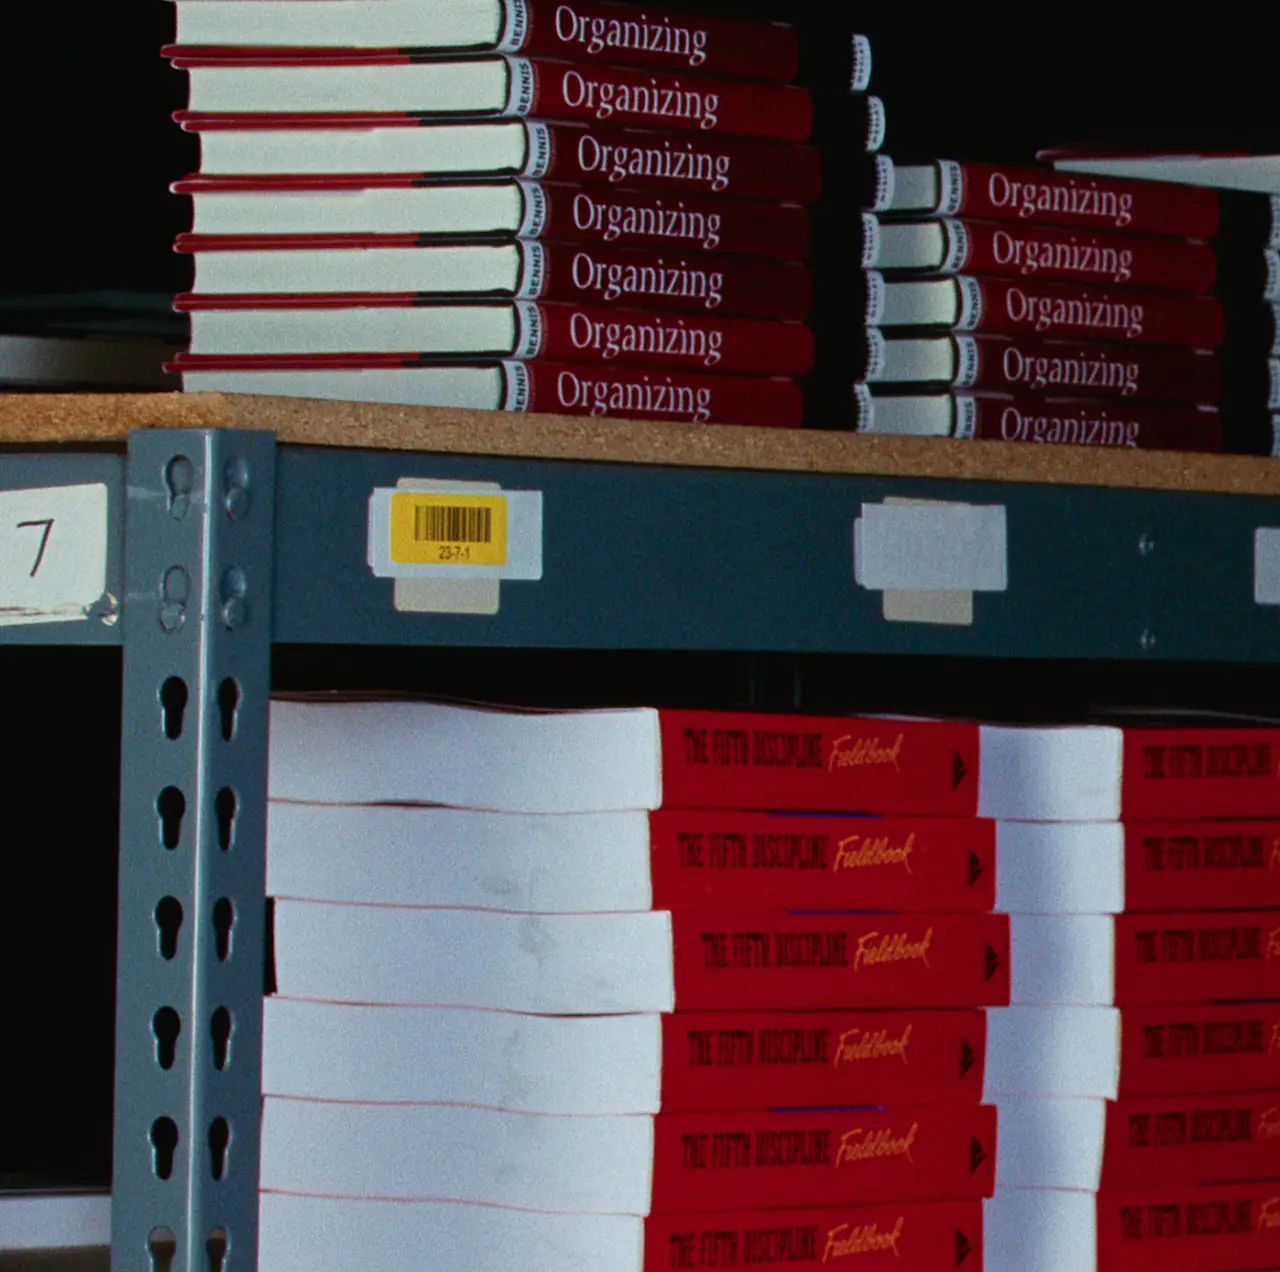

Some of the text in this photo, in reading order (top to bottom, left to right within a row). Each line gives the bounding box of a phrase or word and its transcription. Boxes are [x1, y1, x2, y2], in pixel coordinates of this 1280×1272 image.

[555, 5, 707, 66] Organizing
[517, 62, 529, 114] BENNIS
[562, 70, 719, 130] Organizing
[577, 135, 730, 192] Organizing
[573, 193, 721, 249] Organizing
[988, 172, 1134, 224] Organizing
[528, 245, 541, 295] BENNIS
[571, 252, 723, 309] Organizing
[993, 231, 1132, 282] Organizing
[526, 305, 539, 356] BENNIS
[569, 312, 722, 366] Organizing
[1006, 289, 1143, 338] Organizing
[557, 371, 711, 423] Organizing
[1003, 348, 1139, 395] Organizing
[1000, 408, 1139, 448] Organizing
[16, 518, 55, 578] 7
[684, 729, 904, 773] THE FIFTH DISCIPLINE Fieldbook
[678, 832, 916, 874] THE FIFTH DISCIPLINE Fieldbook
[701, 927, 933, 972] THE FIFTH DISCIPLINE Fieldbook
[688, 1023, 912, 1069] THE FIFTH DISCIPLINE Fieldbook
[682, 1121, 918, 1170] THE FIFTH DISCIPLINE Fieldbook
[669, 1216, 904, 1269] THE FIFTH DISCIPLINE Fieldbook
